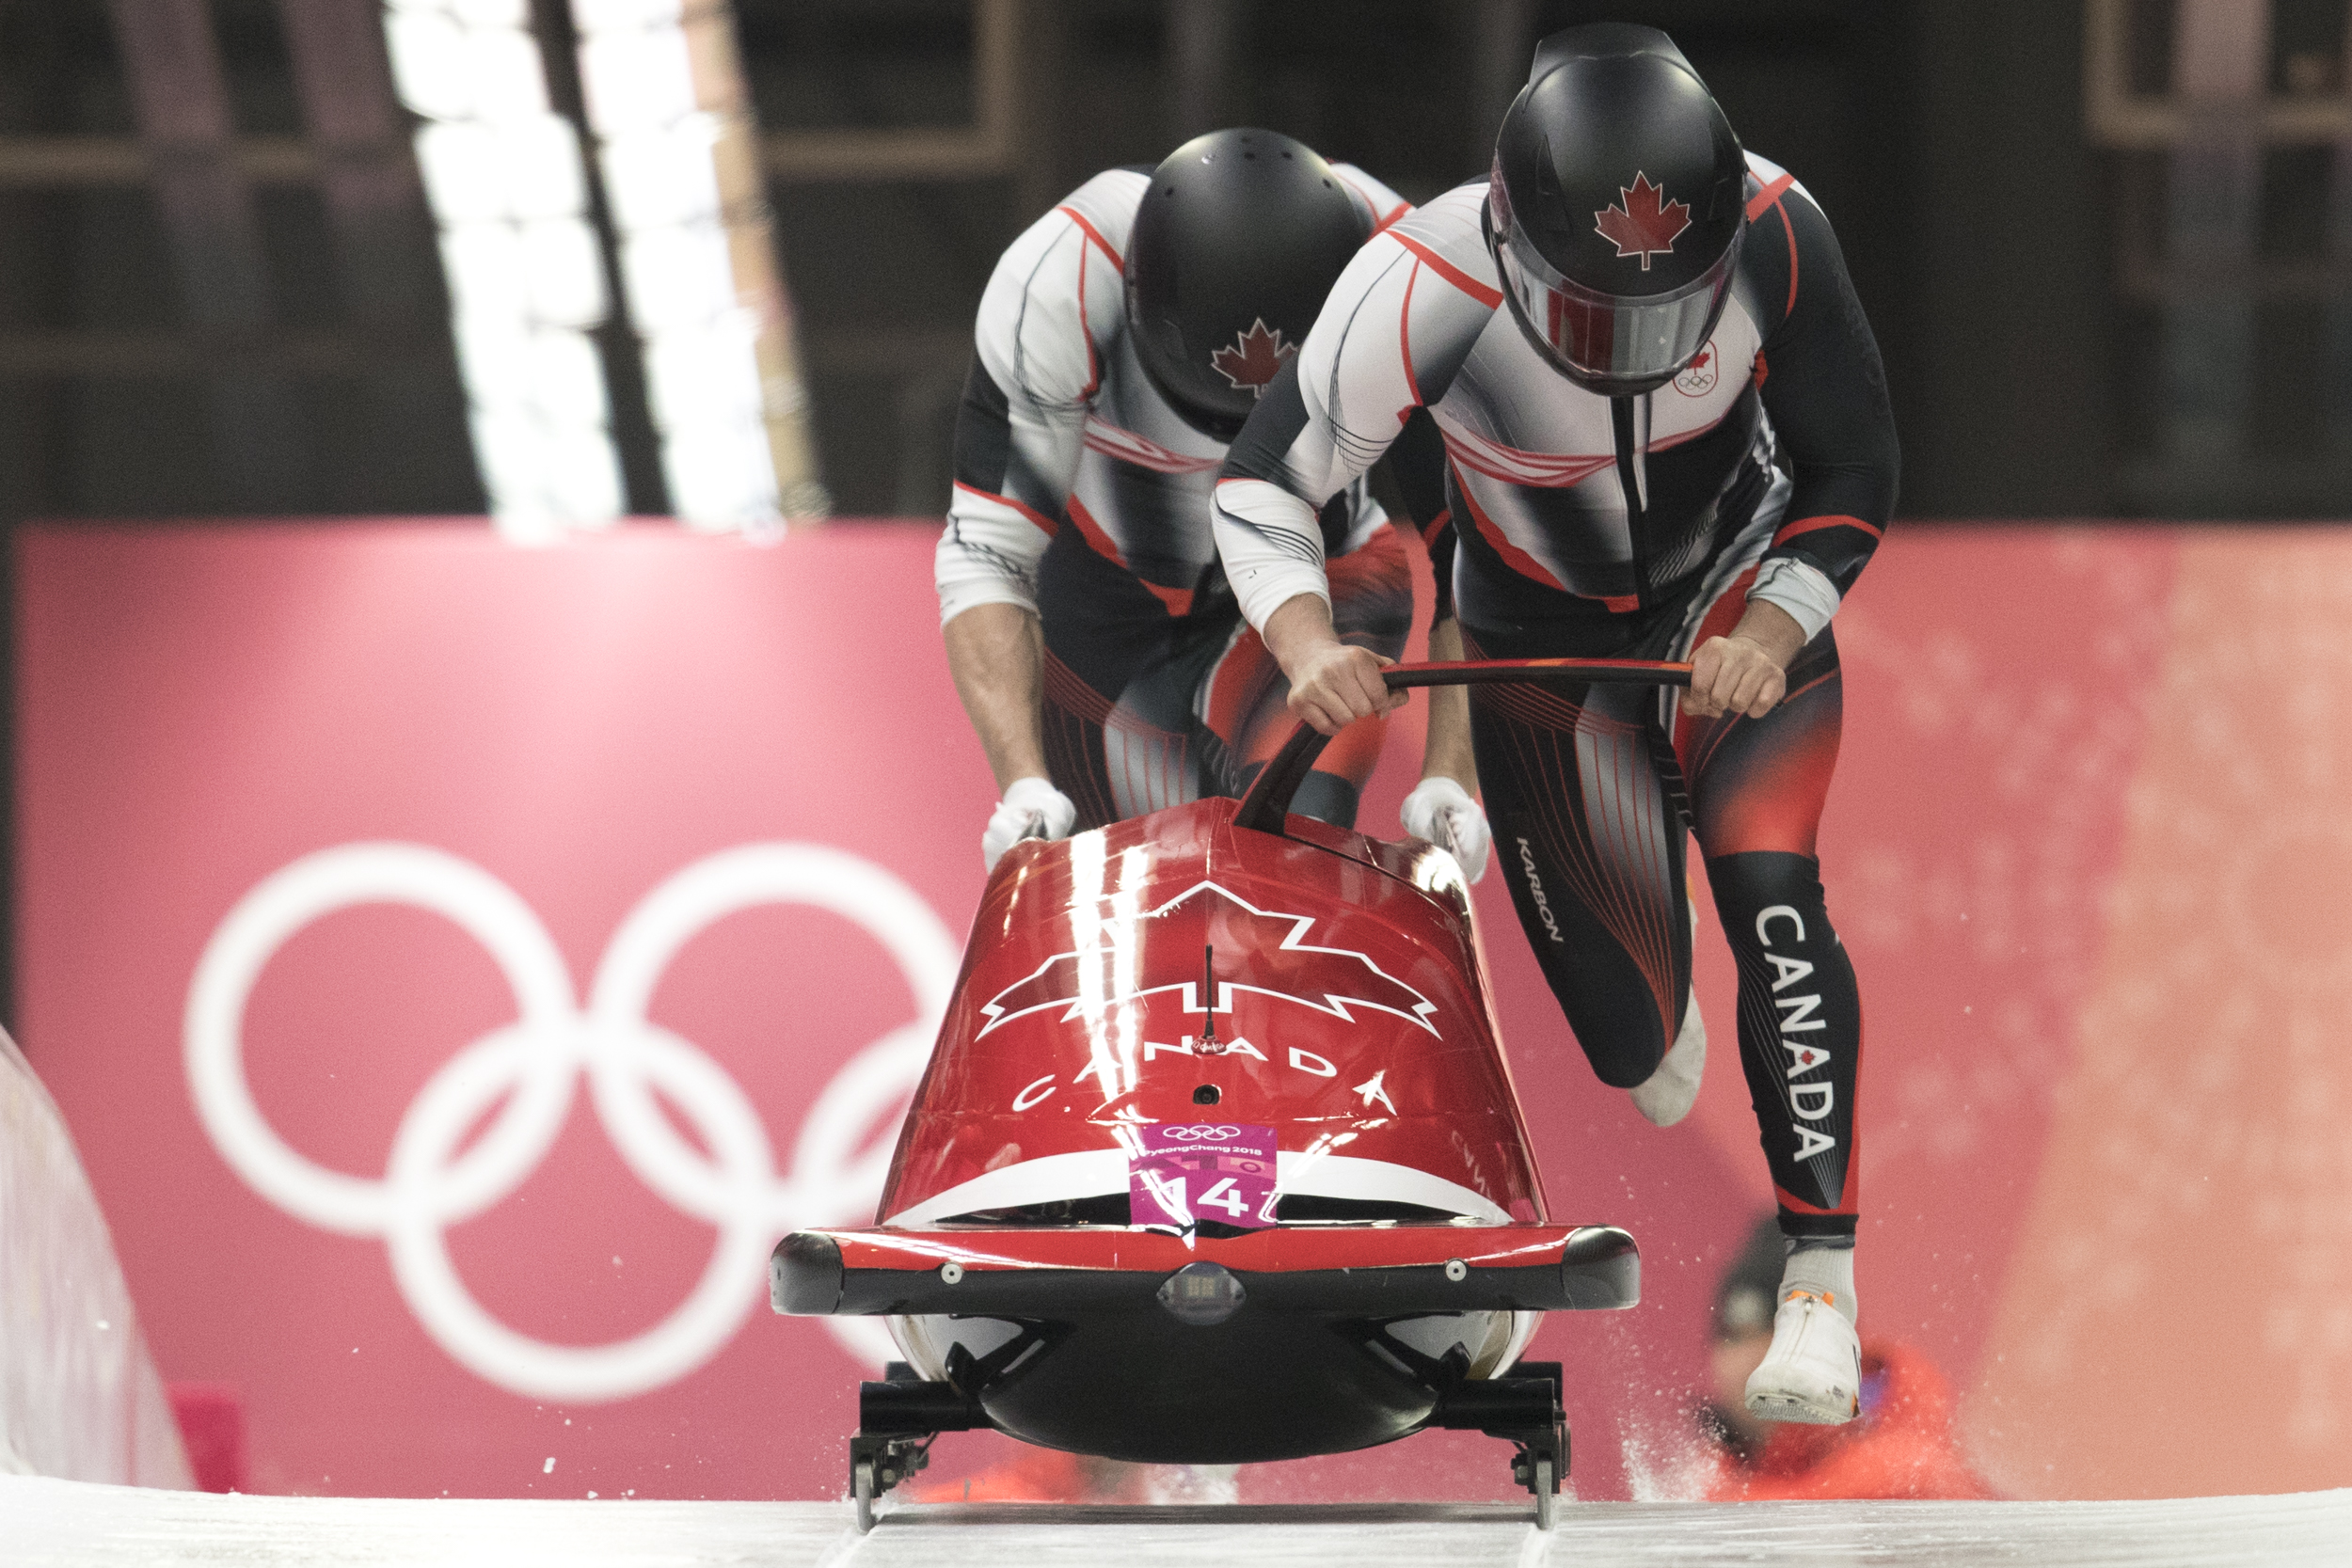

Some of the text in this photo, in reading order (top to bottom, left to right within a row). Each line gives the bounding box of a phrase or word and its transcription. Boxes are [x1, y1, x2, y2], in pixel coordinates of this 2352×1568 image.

[1517, 837, 1564, 942] KARBON
[1756, 905, 1836, 1163] CANADA
[1012, 1036, 1397, 1117] CANADA
[1232, 1146, 1263, 1156] 2018
[1159, 1177, 1249, 1218] 14
